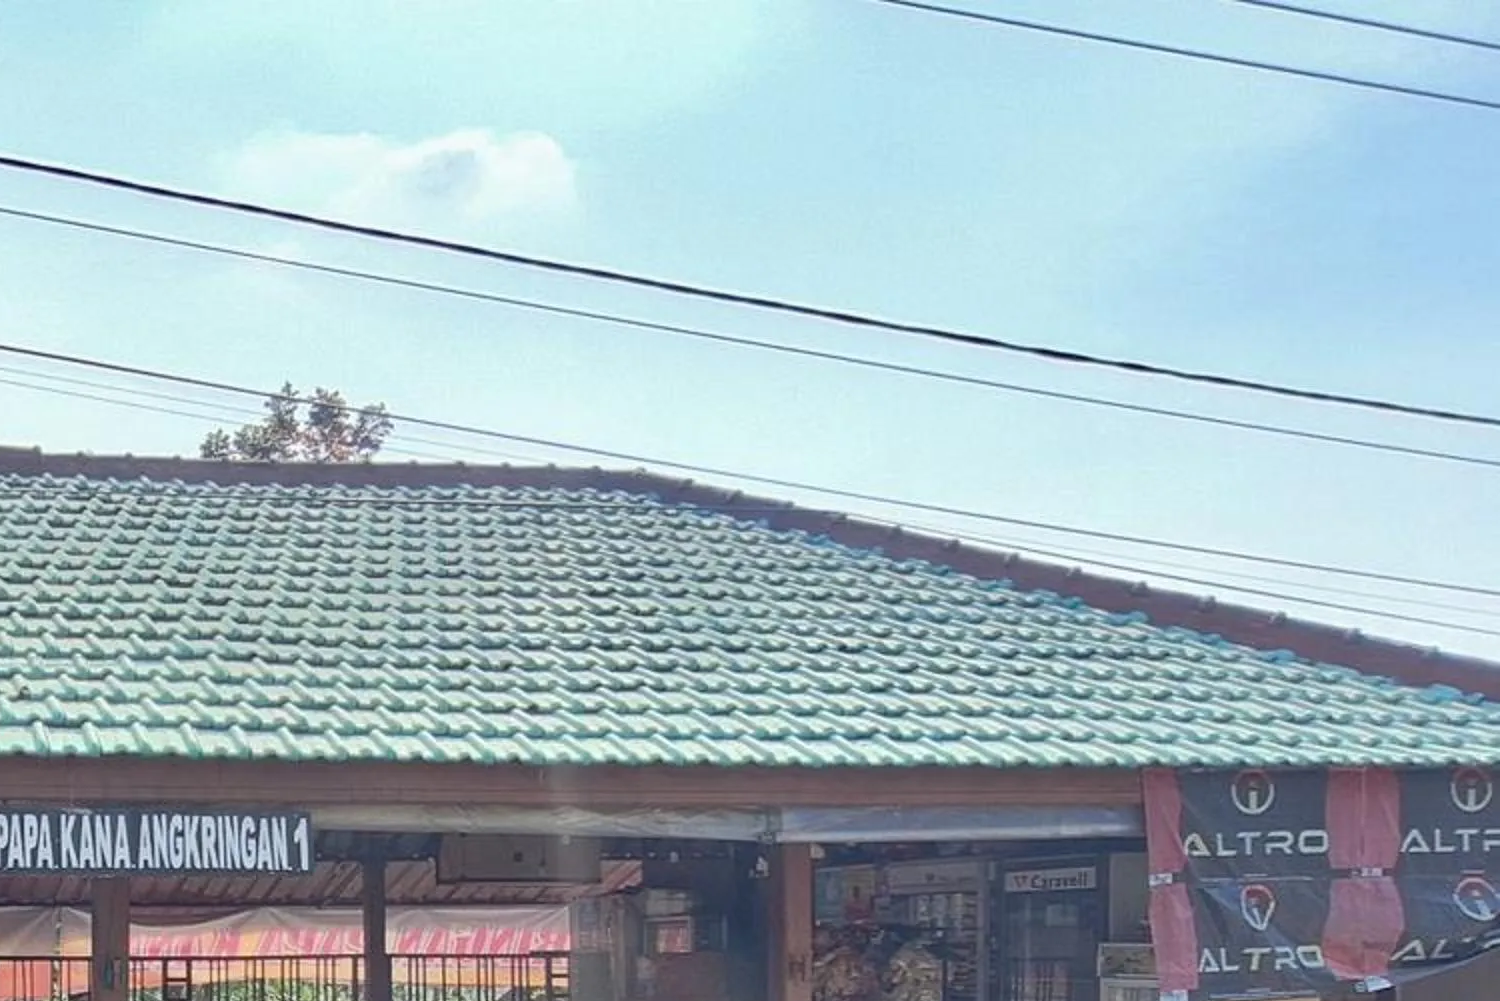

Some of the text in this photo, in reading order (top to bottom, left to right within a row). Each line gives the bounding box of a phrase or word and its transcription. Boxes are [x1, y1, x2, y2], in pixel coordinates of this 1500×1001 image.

[293, 816, 309, 871] 1
[1184, 829, 1330, 857] ALTRO
[1197, 944, 1326, 973] ALTRO
